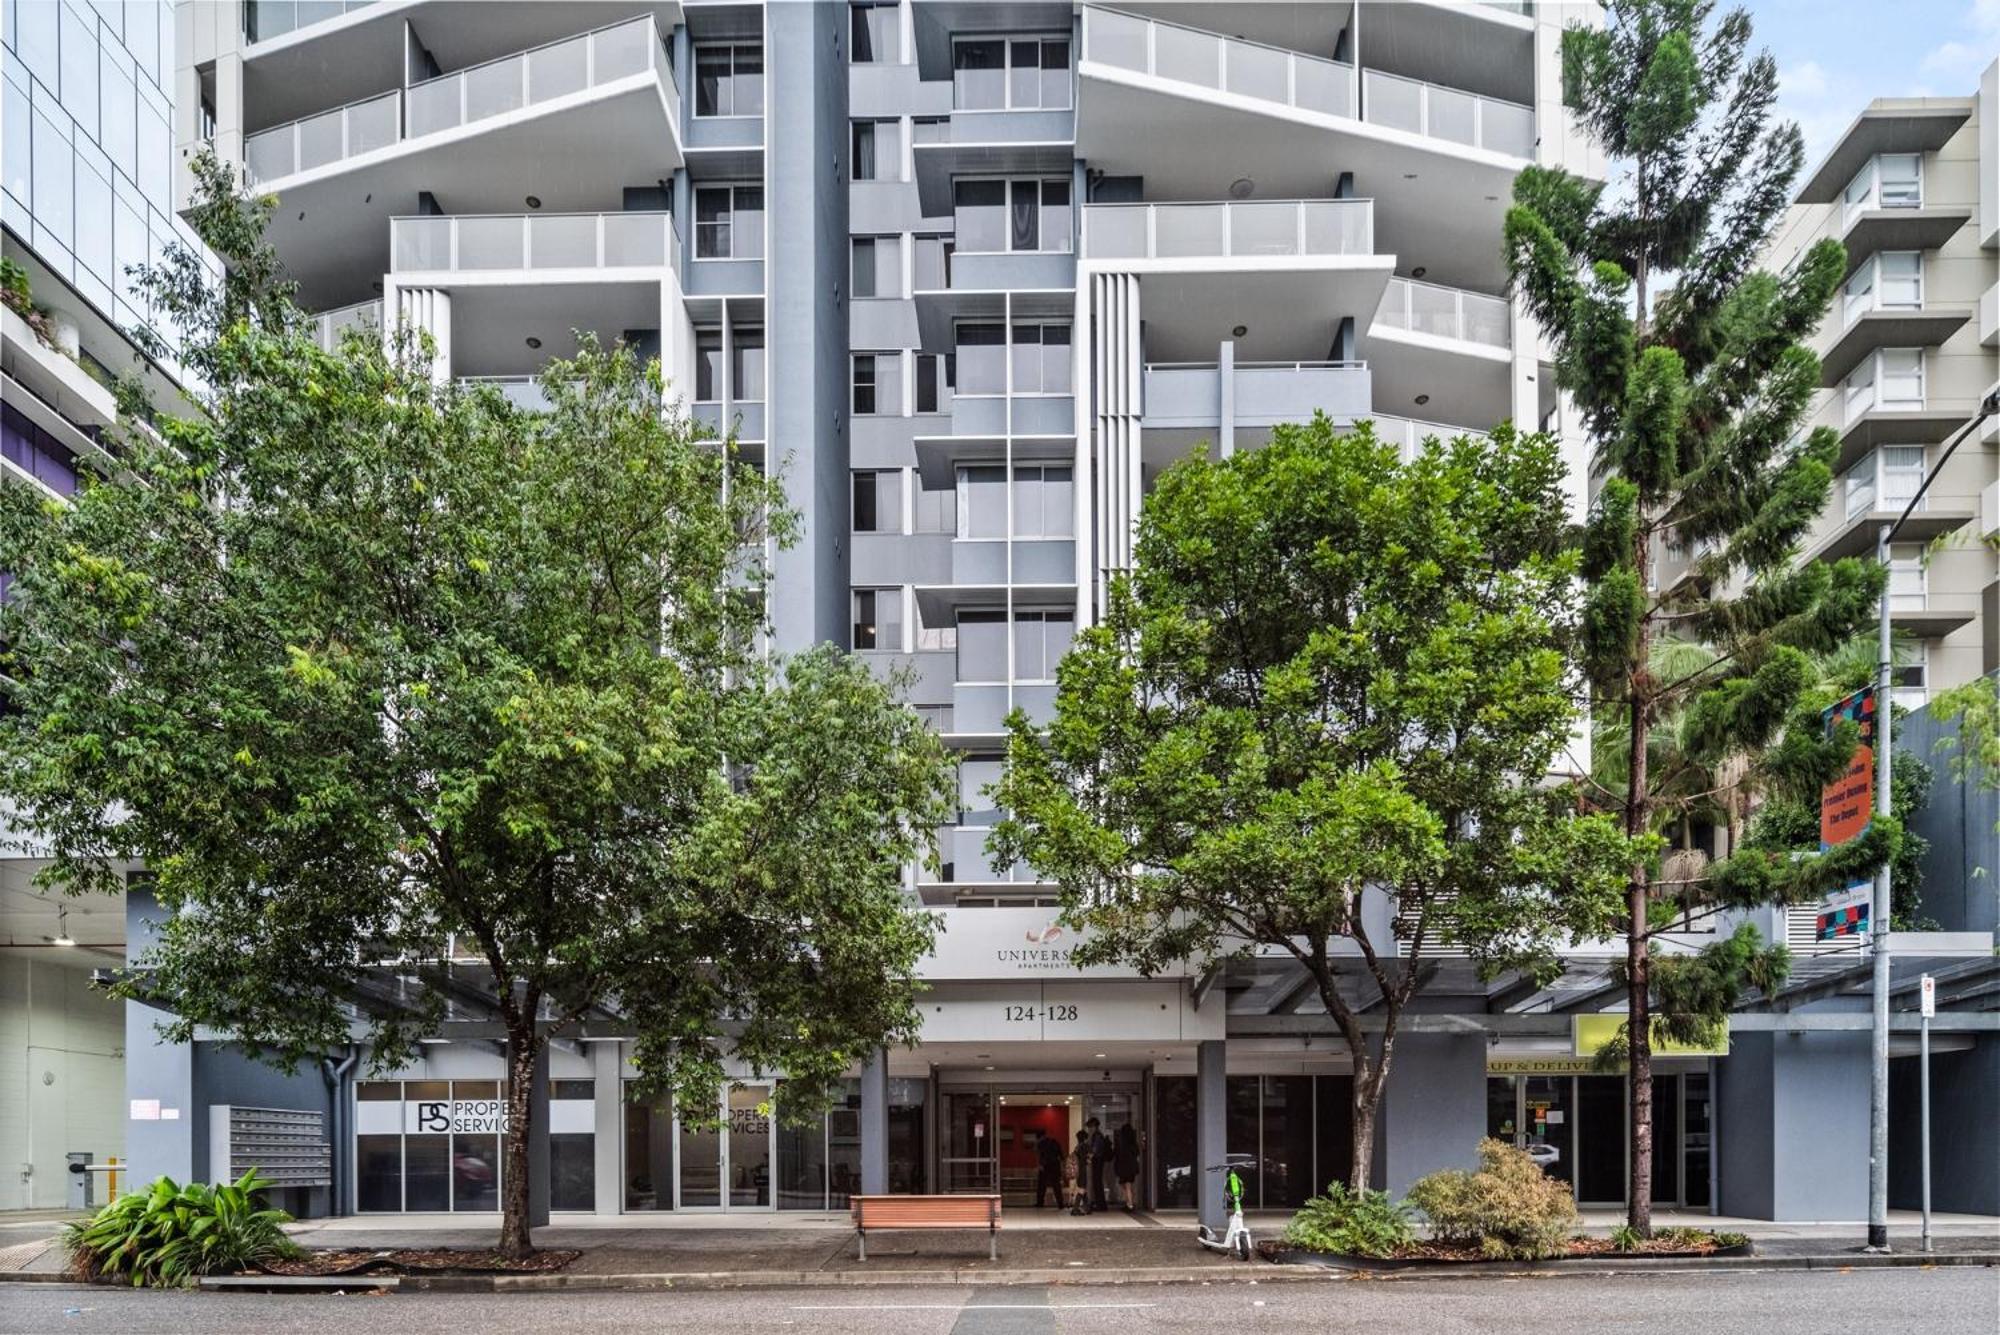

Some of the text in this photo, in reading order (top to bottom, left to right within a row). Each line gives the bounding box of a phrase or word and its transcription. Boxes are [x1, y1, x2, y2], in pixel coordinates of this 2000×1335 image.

[997, 950, 1070, 961] UNIVERS
[1005, 1005, 1078, 1021] 124-128
[1534, 1062, 1590, 1070] DELIV
[455, 1102, 509, 1115] PROPE
[454, 1118, 509, 1132] SERVIC
